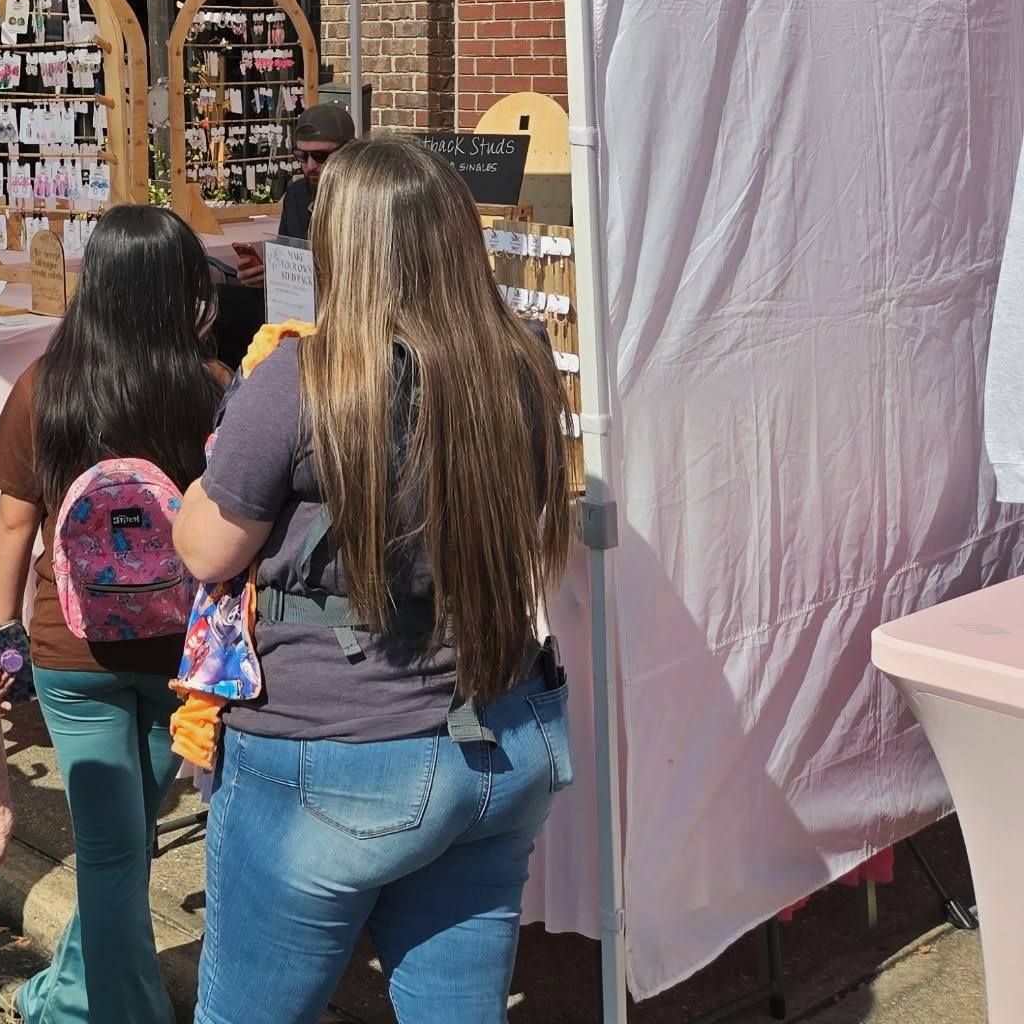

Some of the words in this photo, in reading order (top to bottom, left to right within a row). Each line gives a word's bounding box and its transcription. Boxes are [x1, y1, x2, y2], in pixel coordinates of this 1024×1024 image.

[469, 135, 516, 156] Studs
[458, 161, 499, 173] SINGLES
[288, 250, 304, 261] MAKE
